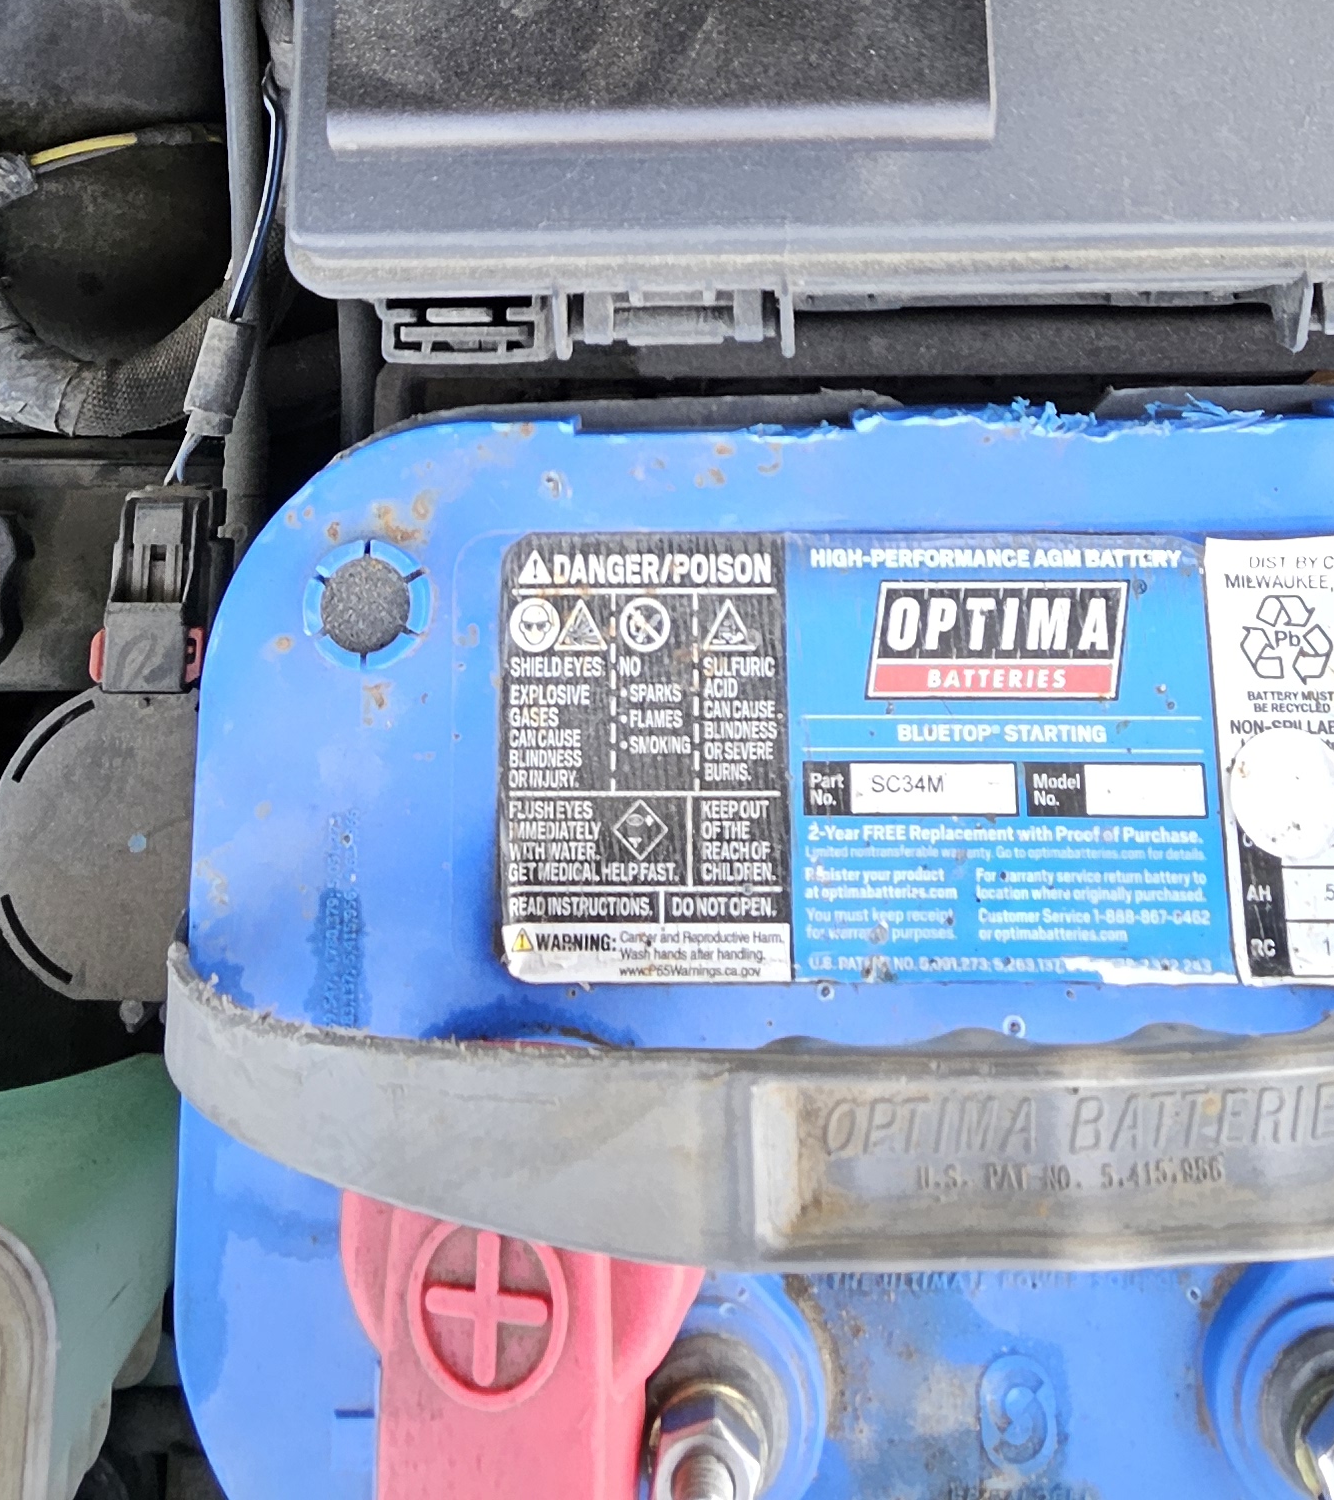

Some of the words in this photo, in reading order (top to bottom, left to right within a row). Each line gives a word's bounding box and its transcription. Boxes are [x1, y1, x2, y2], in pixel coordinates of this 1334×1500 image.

[810, 549, 1030, 568] HIGH-PERFORMANCE
[1033, 549, 1082, 568] AGM
[1085, 549, 1181, 568] BATTERY
[1249, 556, 1286, 569] DIST
[1296, 556, 1318, 568] BY
[553, 553, 771, 584] DANGER/POISON
[886, 597, 1110, 652] OPTIMA
[1274, 630, 1301, 647] Pb
[510, 656, 561, 677] SHIELD
[619, 656, 641, 677] NO
[703, 656, 775, 677] SULFURIC
[703, 679, 738, 698] ACID
[926, 668, 1067, 690] BATTERIES
[509, 684, 590, 705] EXPLOSIVE
[629, 684, 681, 703] SPARKS
[1247, 691, 1299, 702] BATTERY
[1304, 691, 1334, 702] MUST
[509, 707, 559, 727] GASES
[703, 701, 730, 719] CAN
[731, 701, 775, 719] CAUSE
[1253, 703, 1268, 713] BE
[1271, 703, 1331, 713] RECYCLED
[629, 710, 683, 728] FLAMES
[509, 729, 537, 748] CAN
[539, 729, 581, 748] CAUSE
[703, 721, 777, 740] BLINDNESS
[1004, 724, 1107, 743] STARTING
[629, 736, 692, 755] SMOKING
[703, 742, 723, 760] OR
[724, 742, 773, 760] SEVERE
[509, 750, 582, 768] BLINDNESS
[530, 770, 579, 788] INJURY.
[703, 762, 751, 781] BURNS.
[809, 773, 845, 789] Part
[870, 774, 945, 794] SC34M
[1033, 773, 1081, 791] Model
[809, 791, 837, 807] No.
[1034, 791, 1060, 807] No.
[509, 801, 555, 819] FLUSH
[556, 801, 593, 819] EYES
[702, 800, 739, 819] KEEP
[739, 800, 769, 819] OUT
[509, 822, 601, 840] IMMEDIATELY
[702, 822, 721, 840] OF
[722, 822, 749, 840] THE
[808, 823, 860, 841] 2-Year
[863, 825, 906, 841] FREE
[910, 825, 1014, 844] Replacement
[1016, 827, 1052, 841] with
[1056, 826, 1101, 843] Proof
[1103, 826, 1120, 842] of
[1123, 827, 1203, 844] Purchase.
[509, 842, 547, 861] WITH
[547, 842, 601, 861] WATER.
[702, 842, 747, 860] REACH
[747, 842, 771, 860] OF
[509, 863, 539, 882] GET
[540, 863, 601, 882] MEDICAL
[601, 863, 639, 882] HELP
[640, 863, 679, 882] FAST.
[702, 862, 776, 882] CHILDREN.
[862, 870, 891, 884] your
[893, 867, 945, 883] product
[976, 868, 996, 882] For
[1056, 870, 1101, 883] service
[1104, 871, 1142, 884] return
[1144, 869, 1190, 887] battery
[1192, 872, 1207, 885] to
[805, 887, 819, 899] at
[821, 886, 957, 902] optimabatteries.com
[976, 886, 1028, 900] location
[1031, 887, 1070, 900] where
[1073, 887, 1132, 904] originally
[1135, 888, 1207, 904] purchased.
[1246, 885, 1272, 902] AH
[509, 898, 547, 917] READ
[547, 898, 653, 917] INSTRUCTIONS.
[671, 897, 695, 917] DO
[697, 897, 727, 917] NOT
[729, 897, 777, 917] OPEN.
[806, 908, 831, 922] You
[834, 909, 869, 922] must
[872, 908, 904, 924] keep
[978, 908, 1040, 924] Customer
[1042, 908, 1091, 924] Service
[535, 932, 617, 952] WARNING:
[661, 931, 680, 944] and
[683, 931, 749, 946] Reproductive
[752, 931, 784, 944] Harm.
[892, 927, 957, 943] purposes.
[994, 926, 1128, 943] optimabatteries.com
[620, 948, 651, 960] Wash
[654, 948, 687, 961] hands
[690, 948, 713, 961] after
[717, 948, 766, 963] handling.
[1250, 938, 1276, 958] RC
[820, 1094, 1039, 1157] OPTIMA
